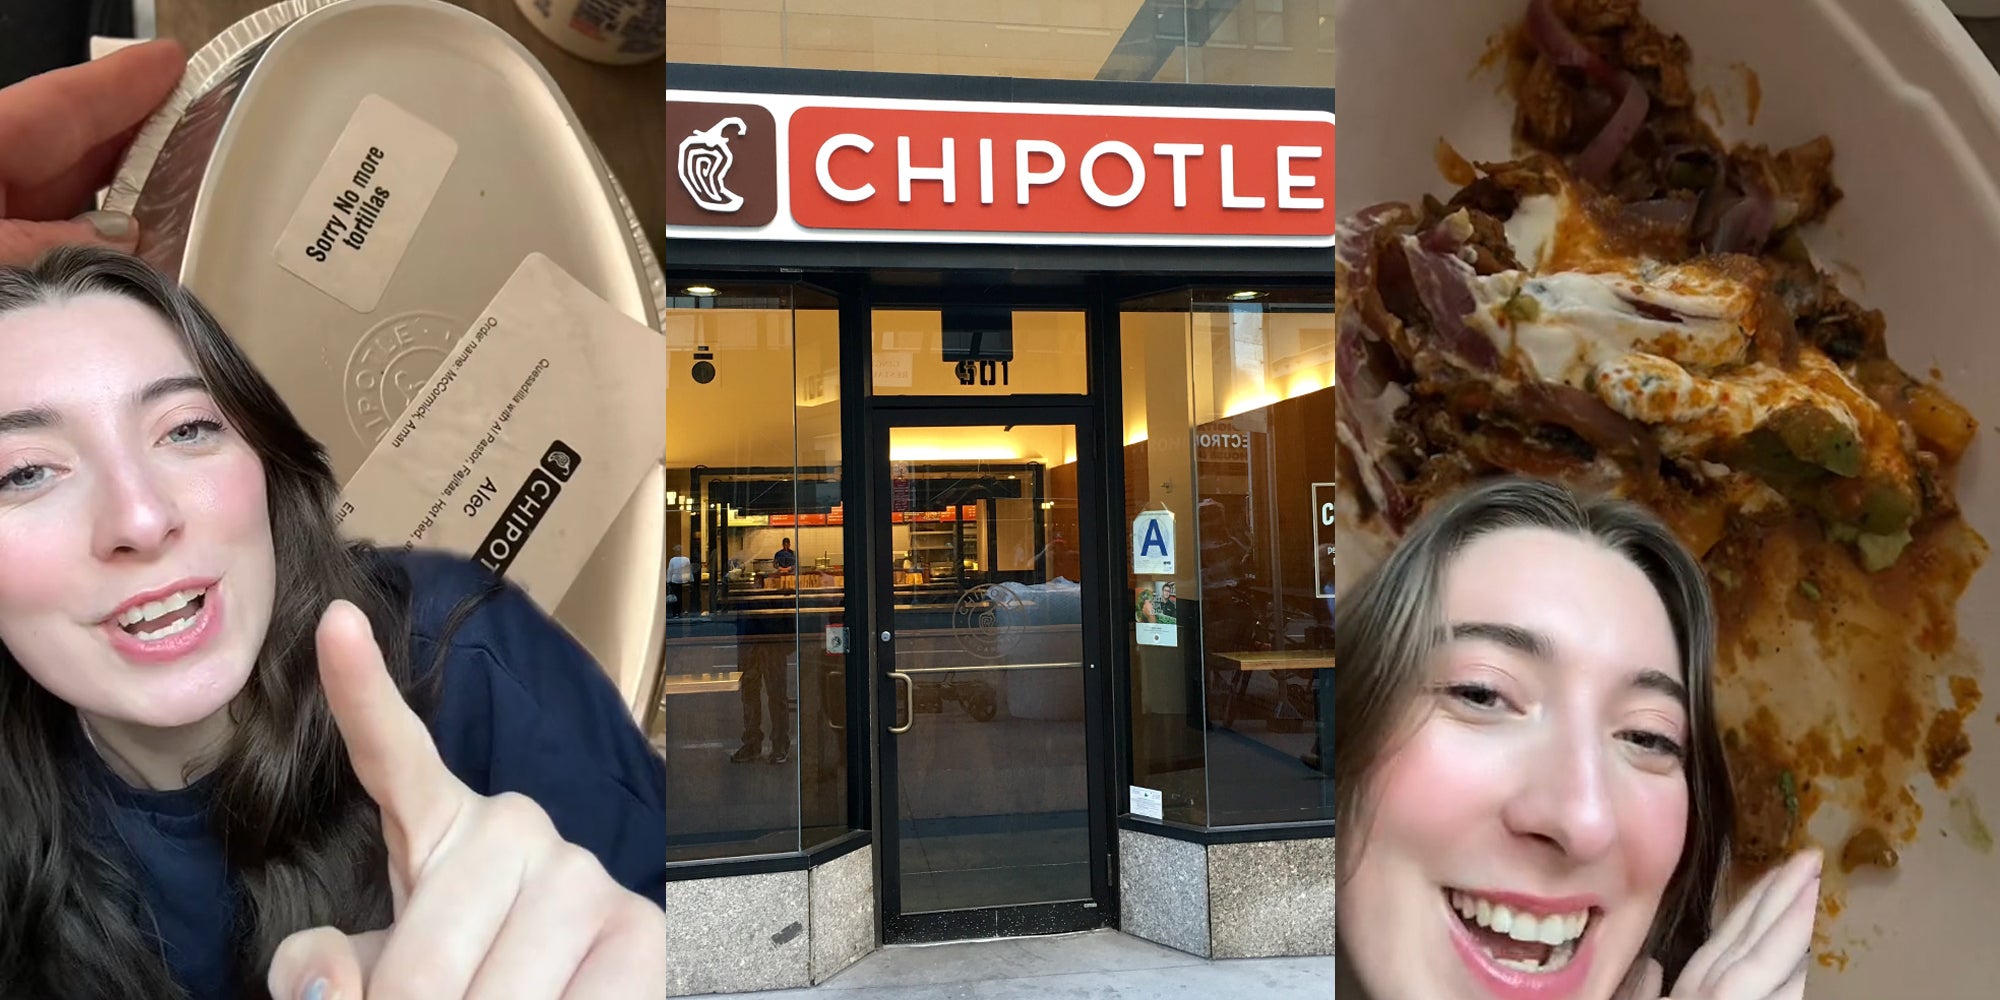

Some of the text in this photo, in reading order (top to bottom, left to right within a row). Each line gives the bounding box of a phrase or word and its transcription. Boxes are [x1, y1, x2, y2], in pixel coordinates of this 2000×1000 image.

[815, 133, 1326, 210] CHIPOTLE
[305, 146, 385, 262] Sorry No more
[342, 186, 390, 250] tortillas
[392, 316, 498, 449] Order name: McCormick, Aman
[512, 358, 550, 404] Quesadilla
[490, 421, 502, 435] Al
[498, 403, 517, 422] with
[464, 432, 496, 464] Pastor,
[441, 465, 472, 496] Fajitas,
[463, 476, 498, 517] Alec
[428, 498, 447, 518] Hot
[410, 516, 434, 540] Red,
[1140, 519, 1168, 557] A
